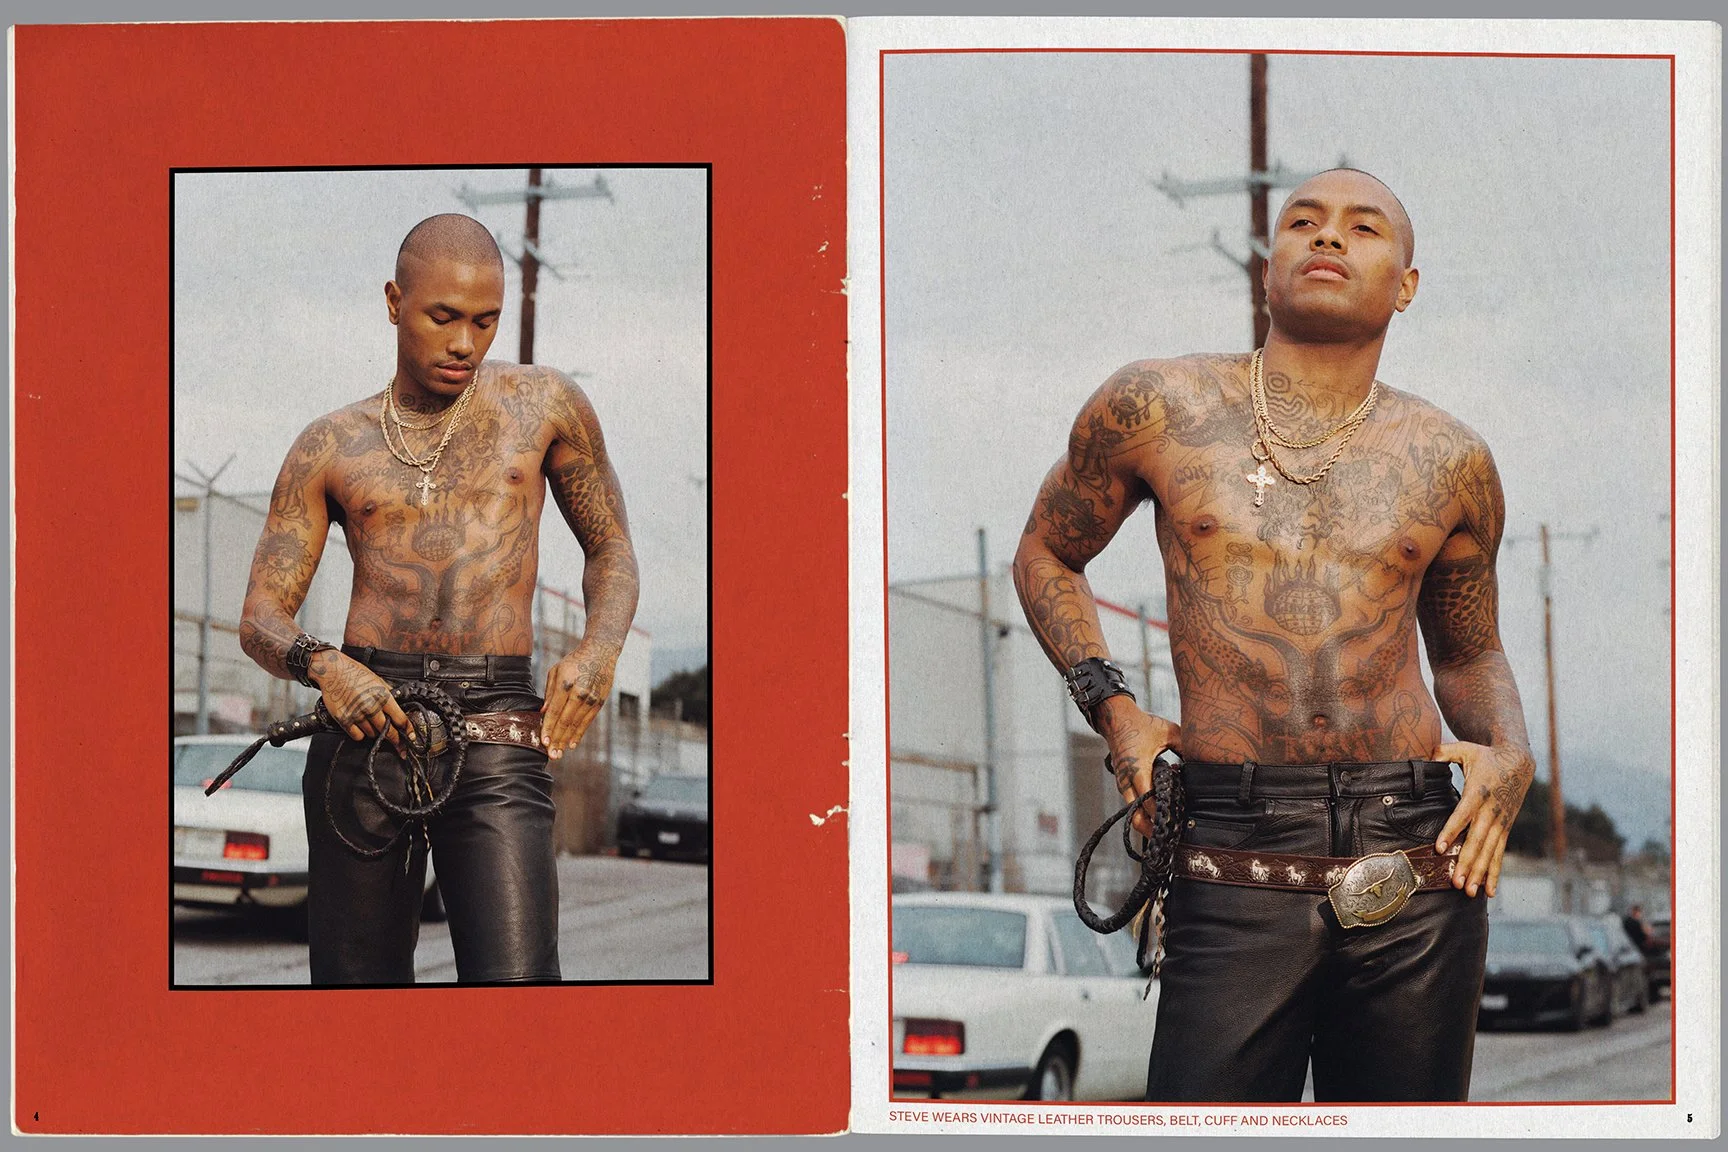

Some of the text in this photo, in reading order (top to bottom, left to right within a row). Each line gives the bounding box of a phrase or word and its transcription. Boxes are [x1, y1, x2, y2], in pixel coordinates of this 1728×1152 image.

[33, 1111, 39, 1121] 4
[889, 1111, 1348, 1127] STEVE WEARS VINTAGE LEATHER TROUSERS, BELT, CUFF AND NECKLACES
[1687, 1113, 1693, 1123] 5
